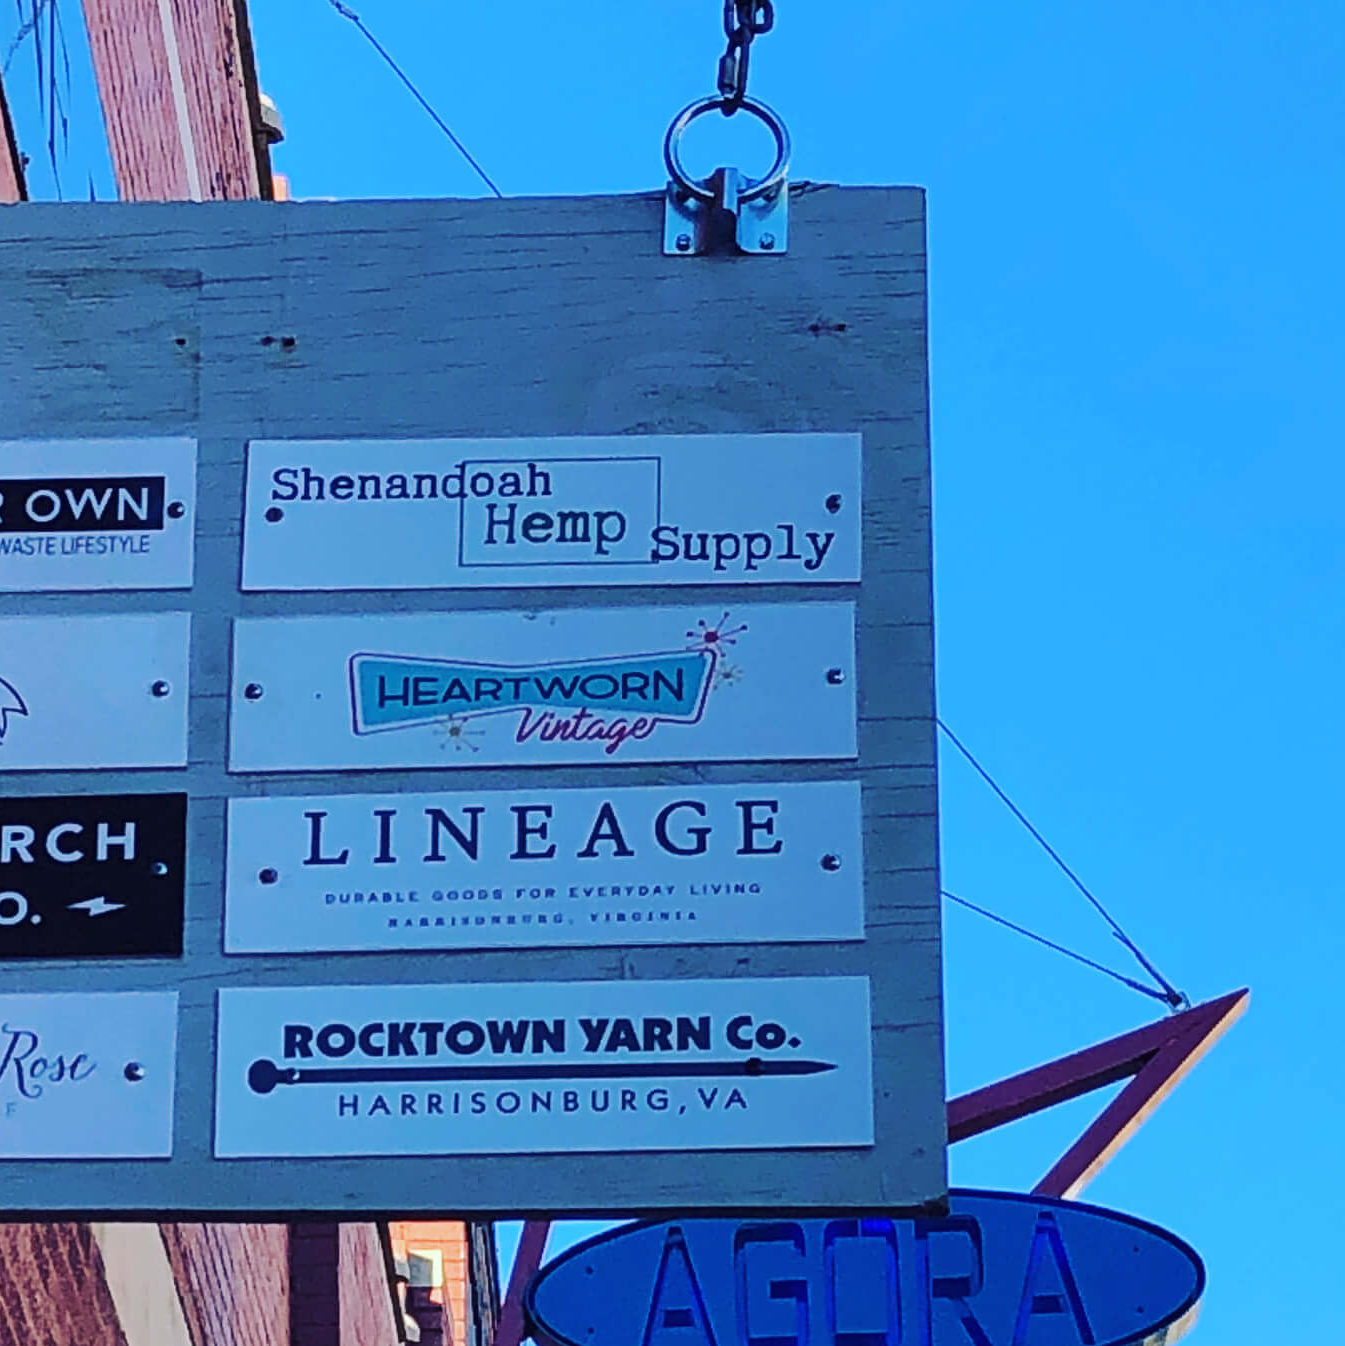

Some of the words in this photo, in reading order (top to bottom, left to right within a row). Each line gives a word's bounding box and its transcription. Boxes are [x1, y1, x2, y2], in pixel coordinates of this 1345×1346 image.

[270, 462, 553, 502] Shenandoah
[25, 486, 149, 523] OWN
[61, 534, 151, 554] LIFESTYLE
[483, 502, 628, 555] Hemp
[650, 523, 836, 570] Supply
[377, 666, 685, 709] HEARTWORN
[516, 705, 657, 755] Vintage
[302, 799, 784, 866] LINEAGE
[324, 890, 420, 905] DURABLE
[431, 888, 504, 902] GOODS
[516, 888, 557, 900] FOR
[568, 885, 676, 899] EVERYDAY
[689, 882, 762, 896] LIVING
[590, 910, 698, 923] VIRGINIA
[282, 1018, 566, 1059] ROCKTOWN
[577, 1015, 712, 1054] YARN
[725, 1014, 803, 1053] Co.
